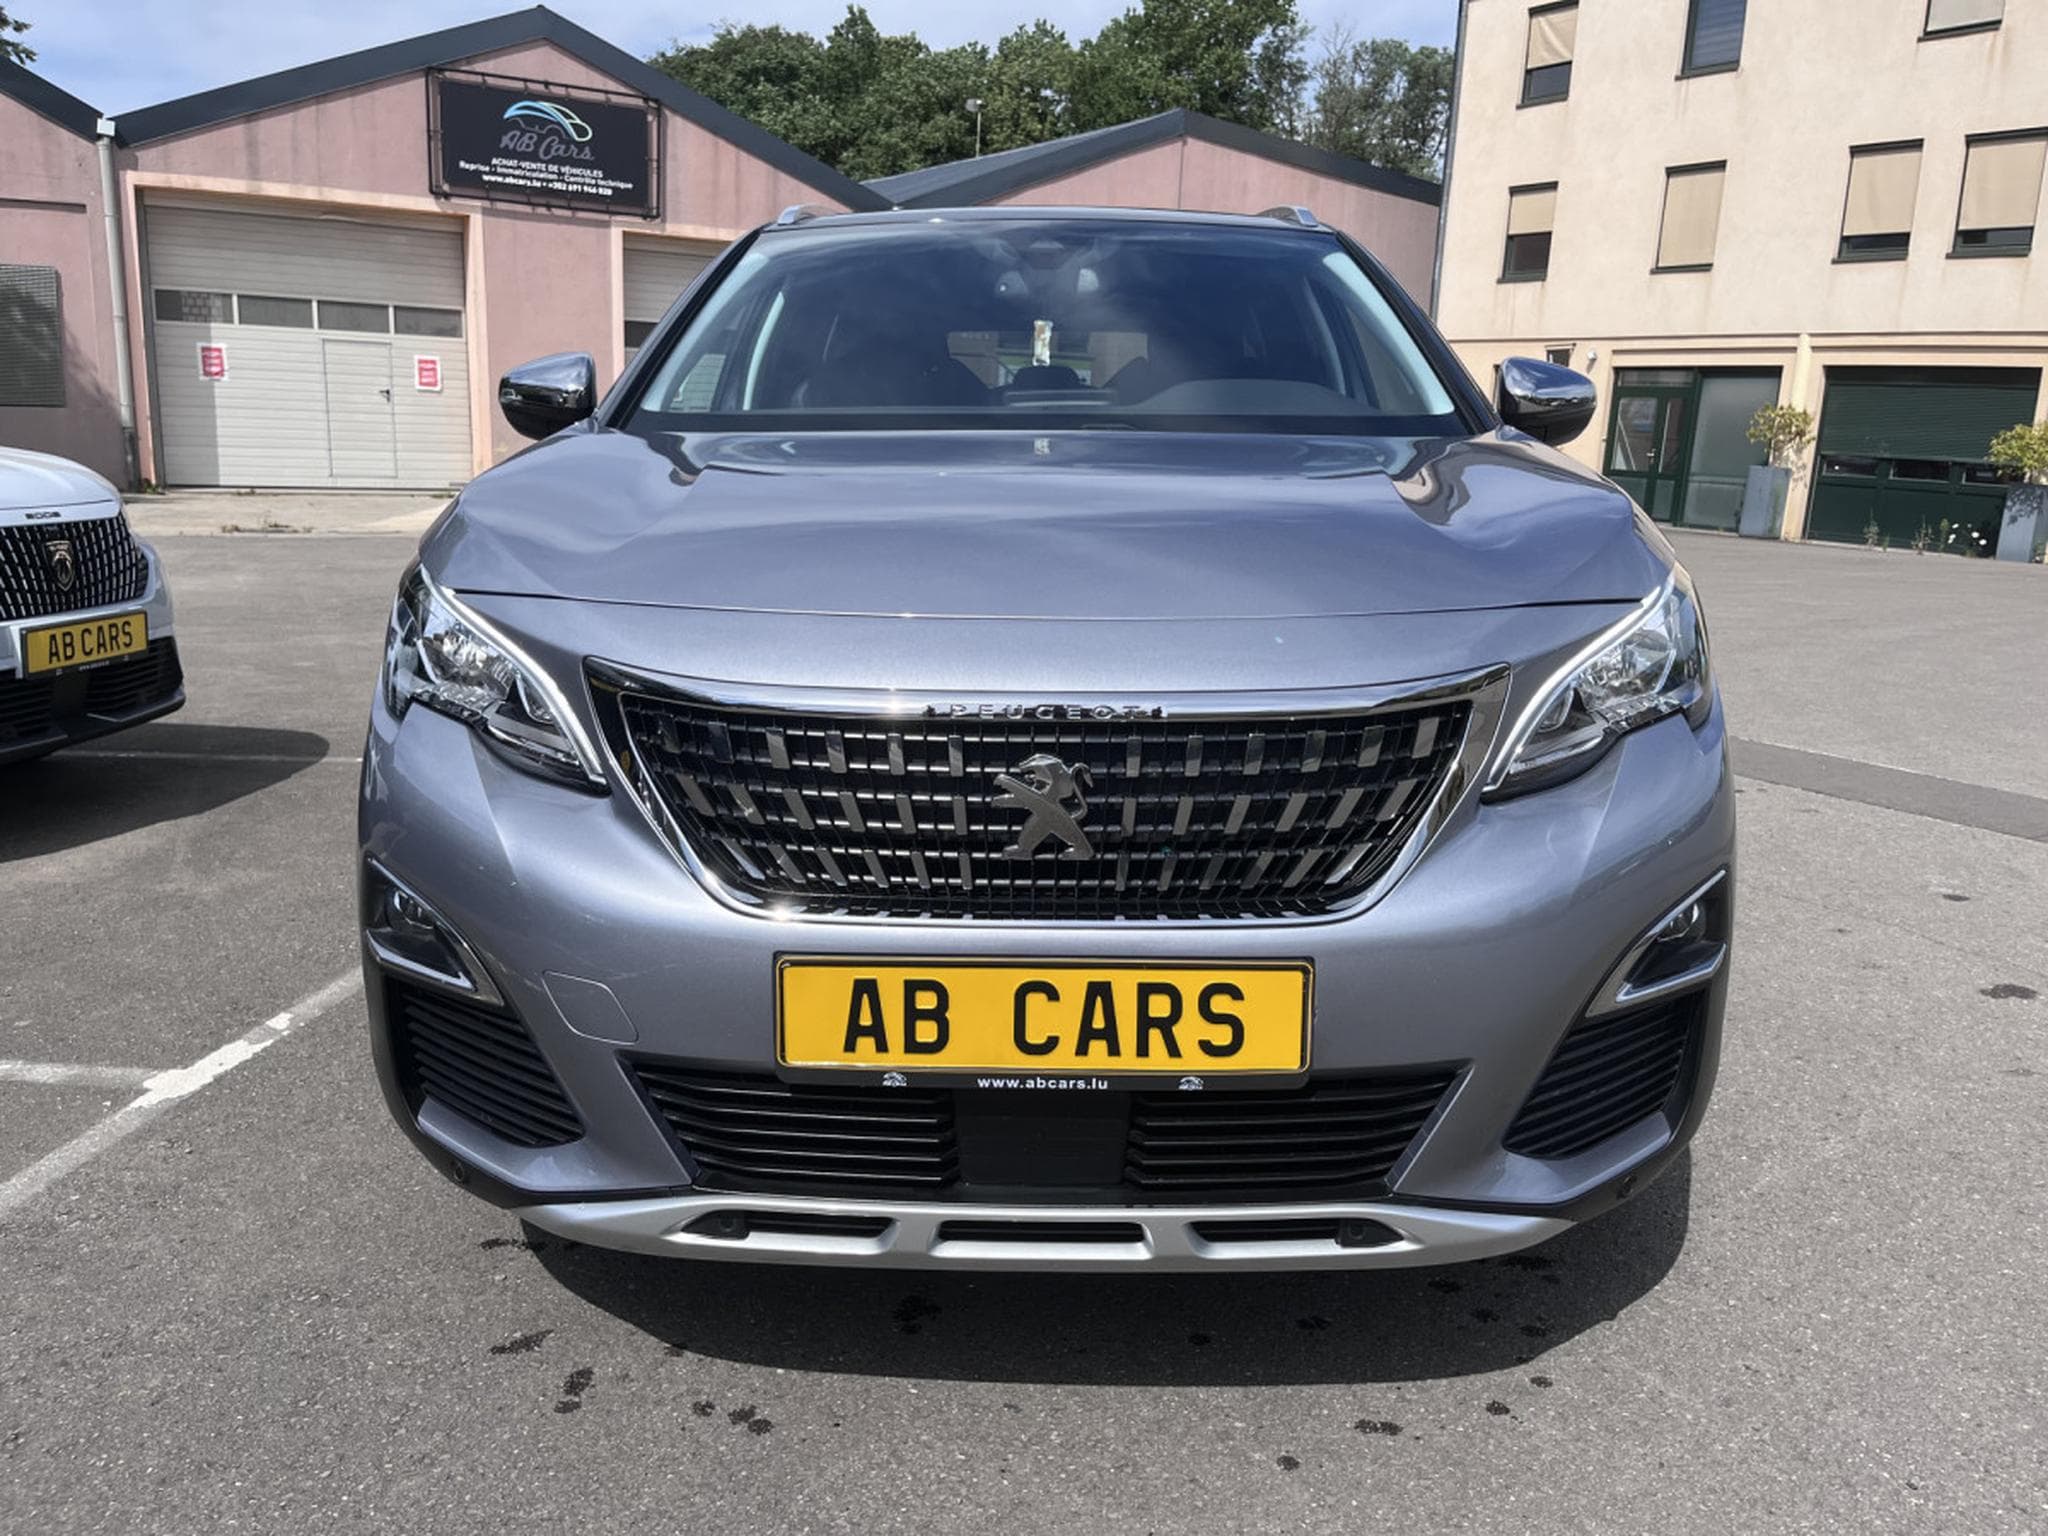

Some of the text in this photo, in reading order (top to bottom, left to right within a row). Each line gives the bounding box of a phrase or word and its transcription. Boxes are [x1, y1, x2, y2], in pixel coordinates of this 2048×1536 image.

[499, 130, 595, 160] AB Cars
[459, 160, 490, 172] Reprise
[597, 179, 634, 189] technique
[547, 164, 559, 173] DE
[560, 165, 604, 178] VÉHICULES
[48, 620, 134, 665] AB CARS
[949, 704, 1141, 720] PEUGEOT
[843, 978, 1246, 1059] AB CARS
[977, 1076, 1108, 1090] www.abcars.lu
